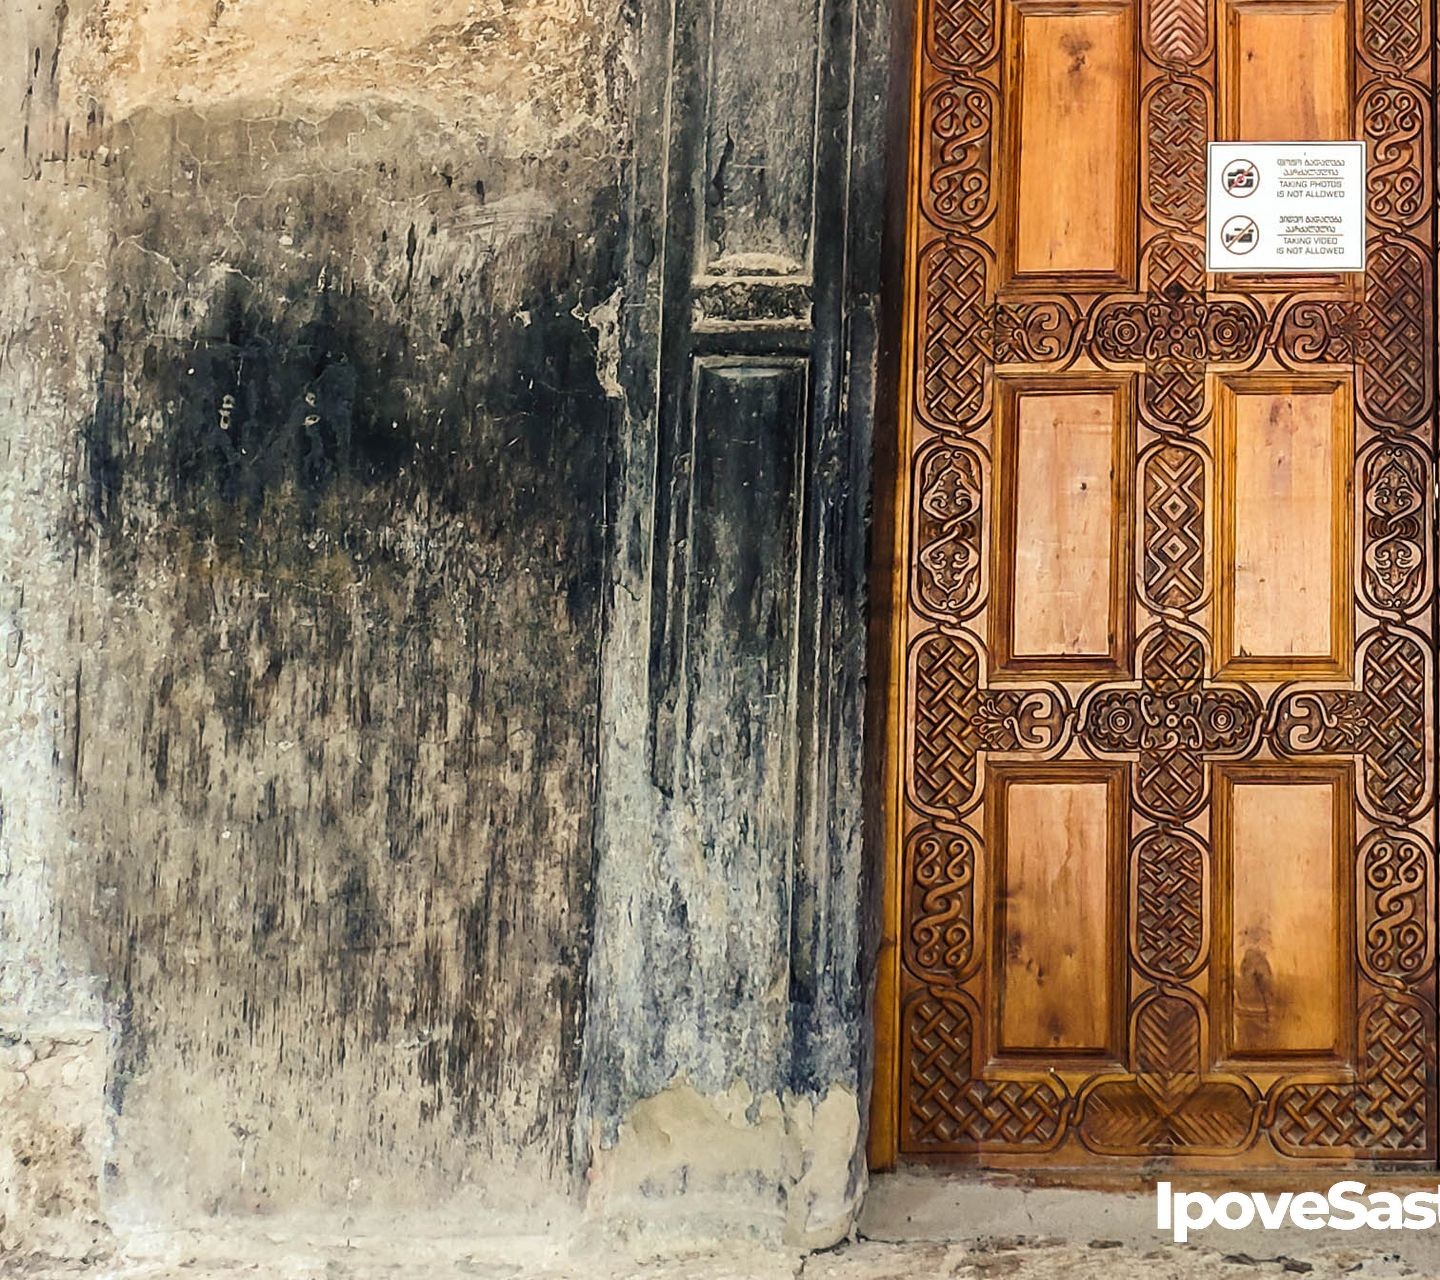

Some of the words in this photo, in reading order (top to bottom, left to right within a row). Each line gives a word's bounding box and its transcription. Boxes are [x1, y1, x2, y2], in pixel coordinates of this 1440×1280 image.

[1280, 180, 1307, 189] TAKING
[1310, 180, 1342, 189] PHOTOS
[1277, 190, 1285, 199] IS
[1287, 190, 1303, 199] NOT
[1305, 190, 1345, 199] ALLOWED
[1284, 237, 1312, 246] TAKING
[1313, 237, 1338, 245] VIDEO
[1276, 246, 1284, 255] IS
[1286, 246, 1303, 255] NOT
[1305, 246, 1345, 255] ALLOWED
